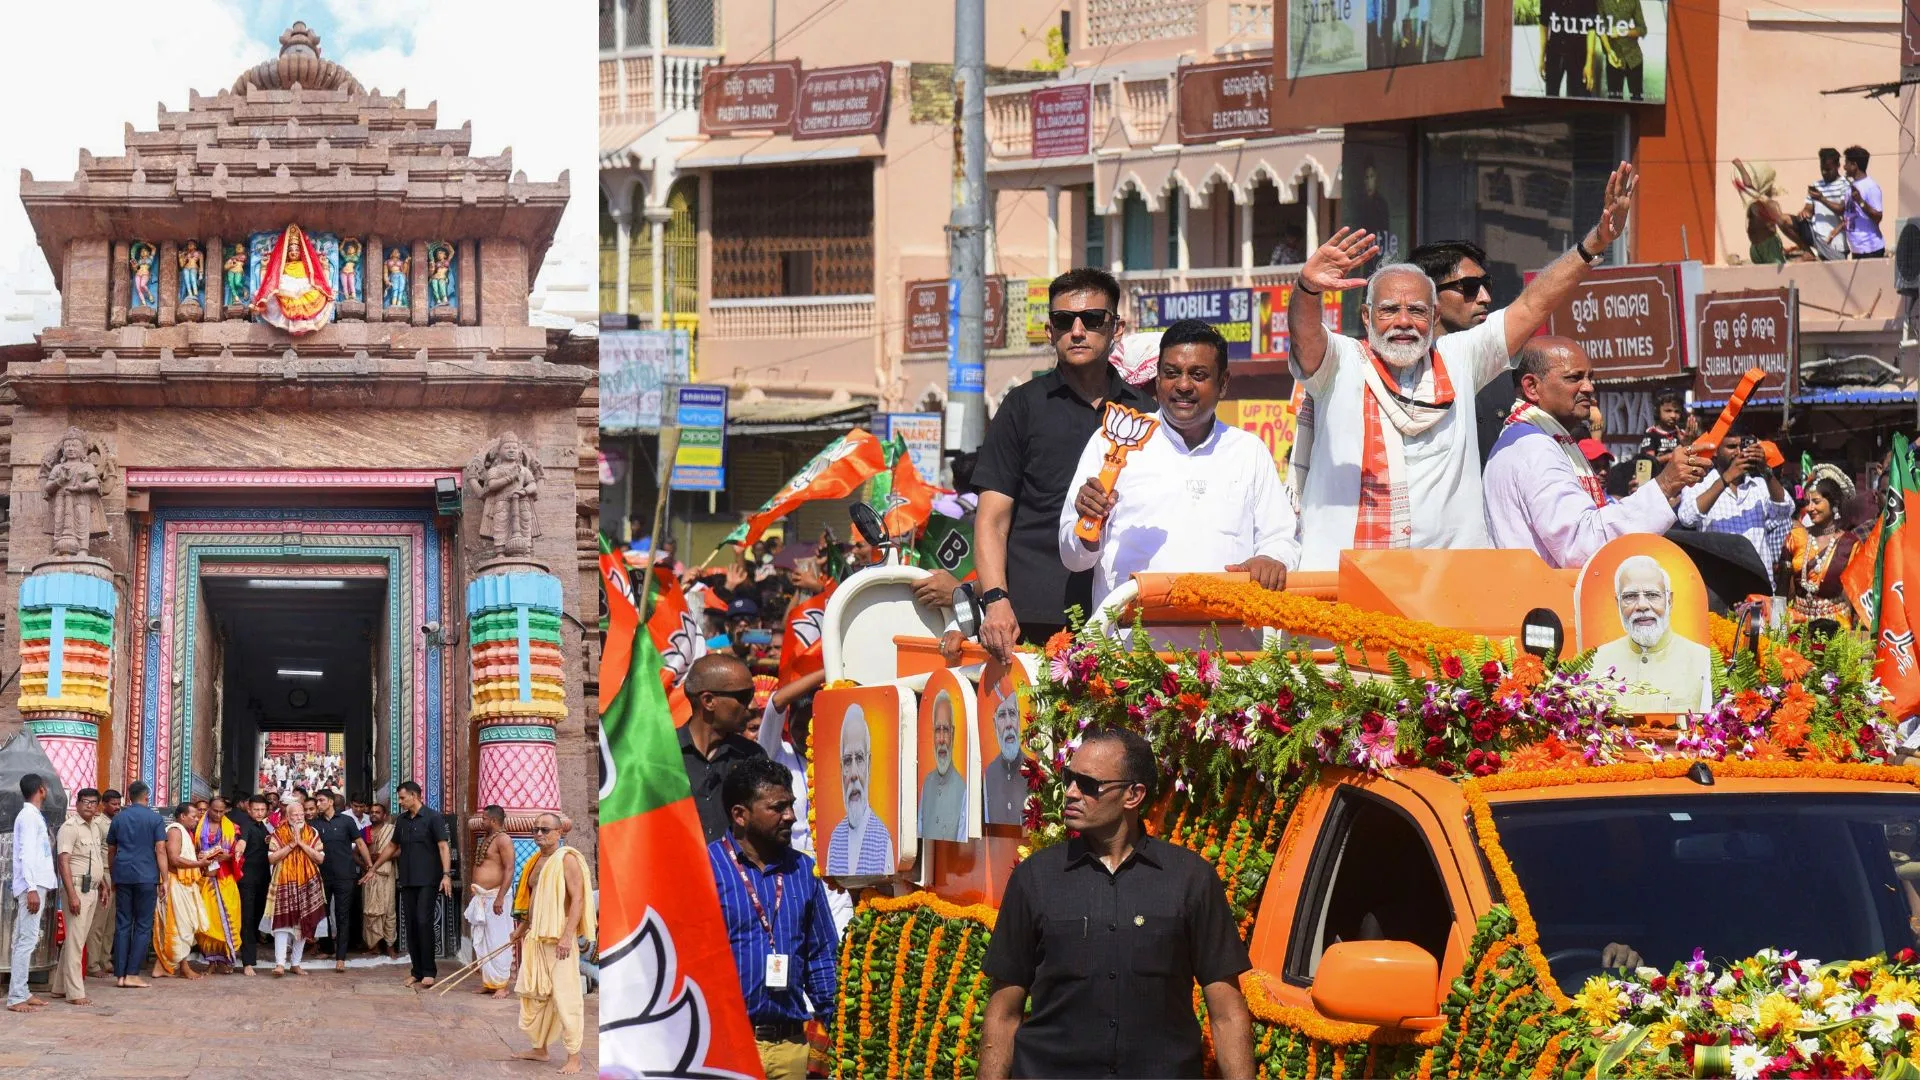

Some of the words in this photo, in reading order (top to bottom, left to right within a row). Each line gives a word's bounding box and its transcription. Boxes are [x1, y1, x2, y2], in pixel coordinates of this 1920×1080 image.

[1550, 11, 1629, 37] turtle
[718, 105, 749, 121] PABITRA
[751, 104, 779, 120] FANCY
[1212, 108, 1269, 130] ELECTRONICS
[1164, 294, 1221, 321] MOBILE
[1615, 336, 1654, 358] TIMES
[1705, 356, 1731, 376] SUBHA
[1732, 354, 1758, 375] CHUDI
[1759, 353, 1786, 374] MAHAL
[1243, 405, 1261, 417] UP
[1265, 404, 1282, 418] TO
[1600, 391, 1656, 435] RYA
[936, 528, 970, 571] B
